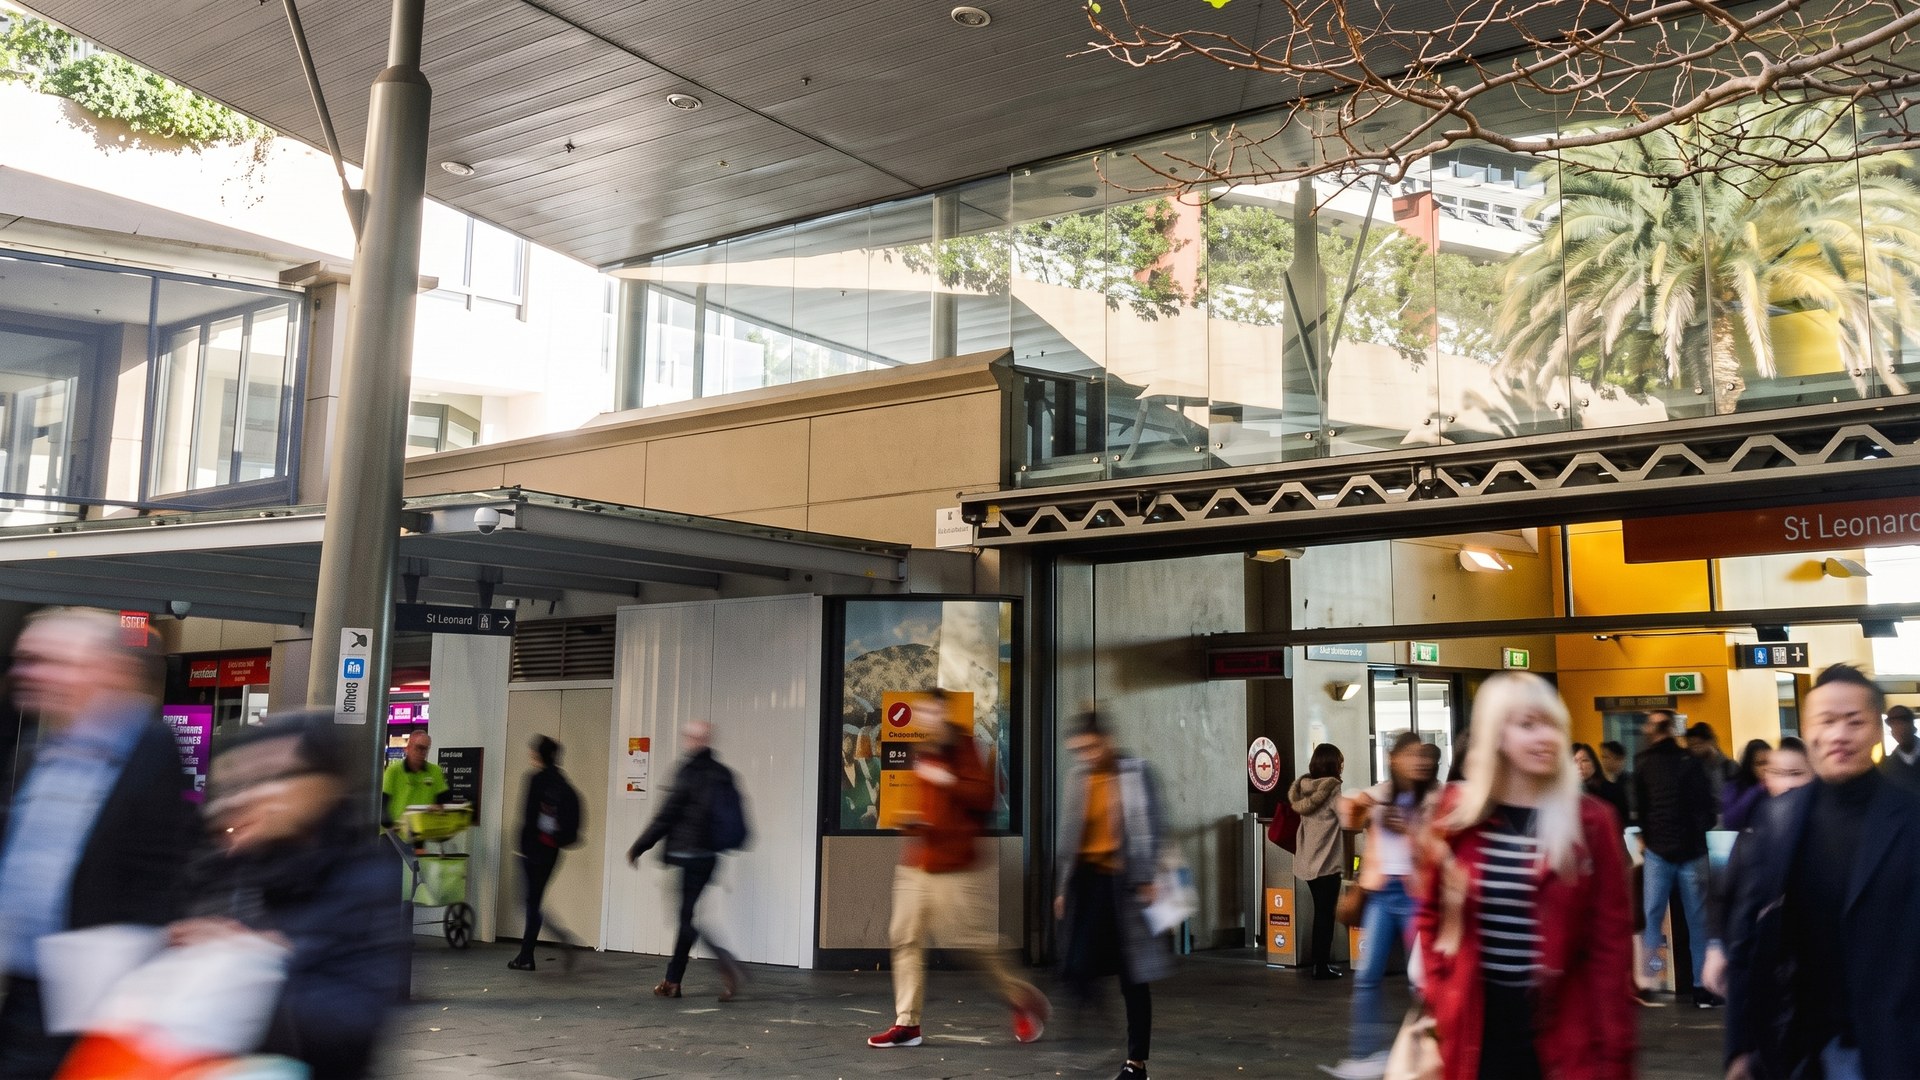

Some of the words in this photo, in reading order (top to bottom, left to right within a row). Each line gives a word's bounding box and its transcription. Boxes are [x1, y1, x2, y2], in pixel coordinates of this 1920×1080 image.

[1784, 515, 1811, 541] St
[426, 613, 436, 624] St
[438, 614, 473, 625] Leonard
